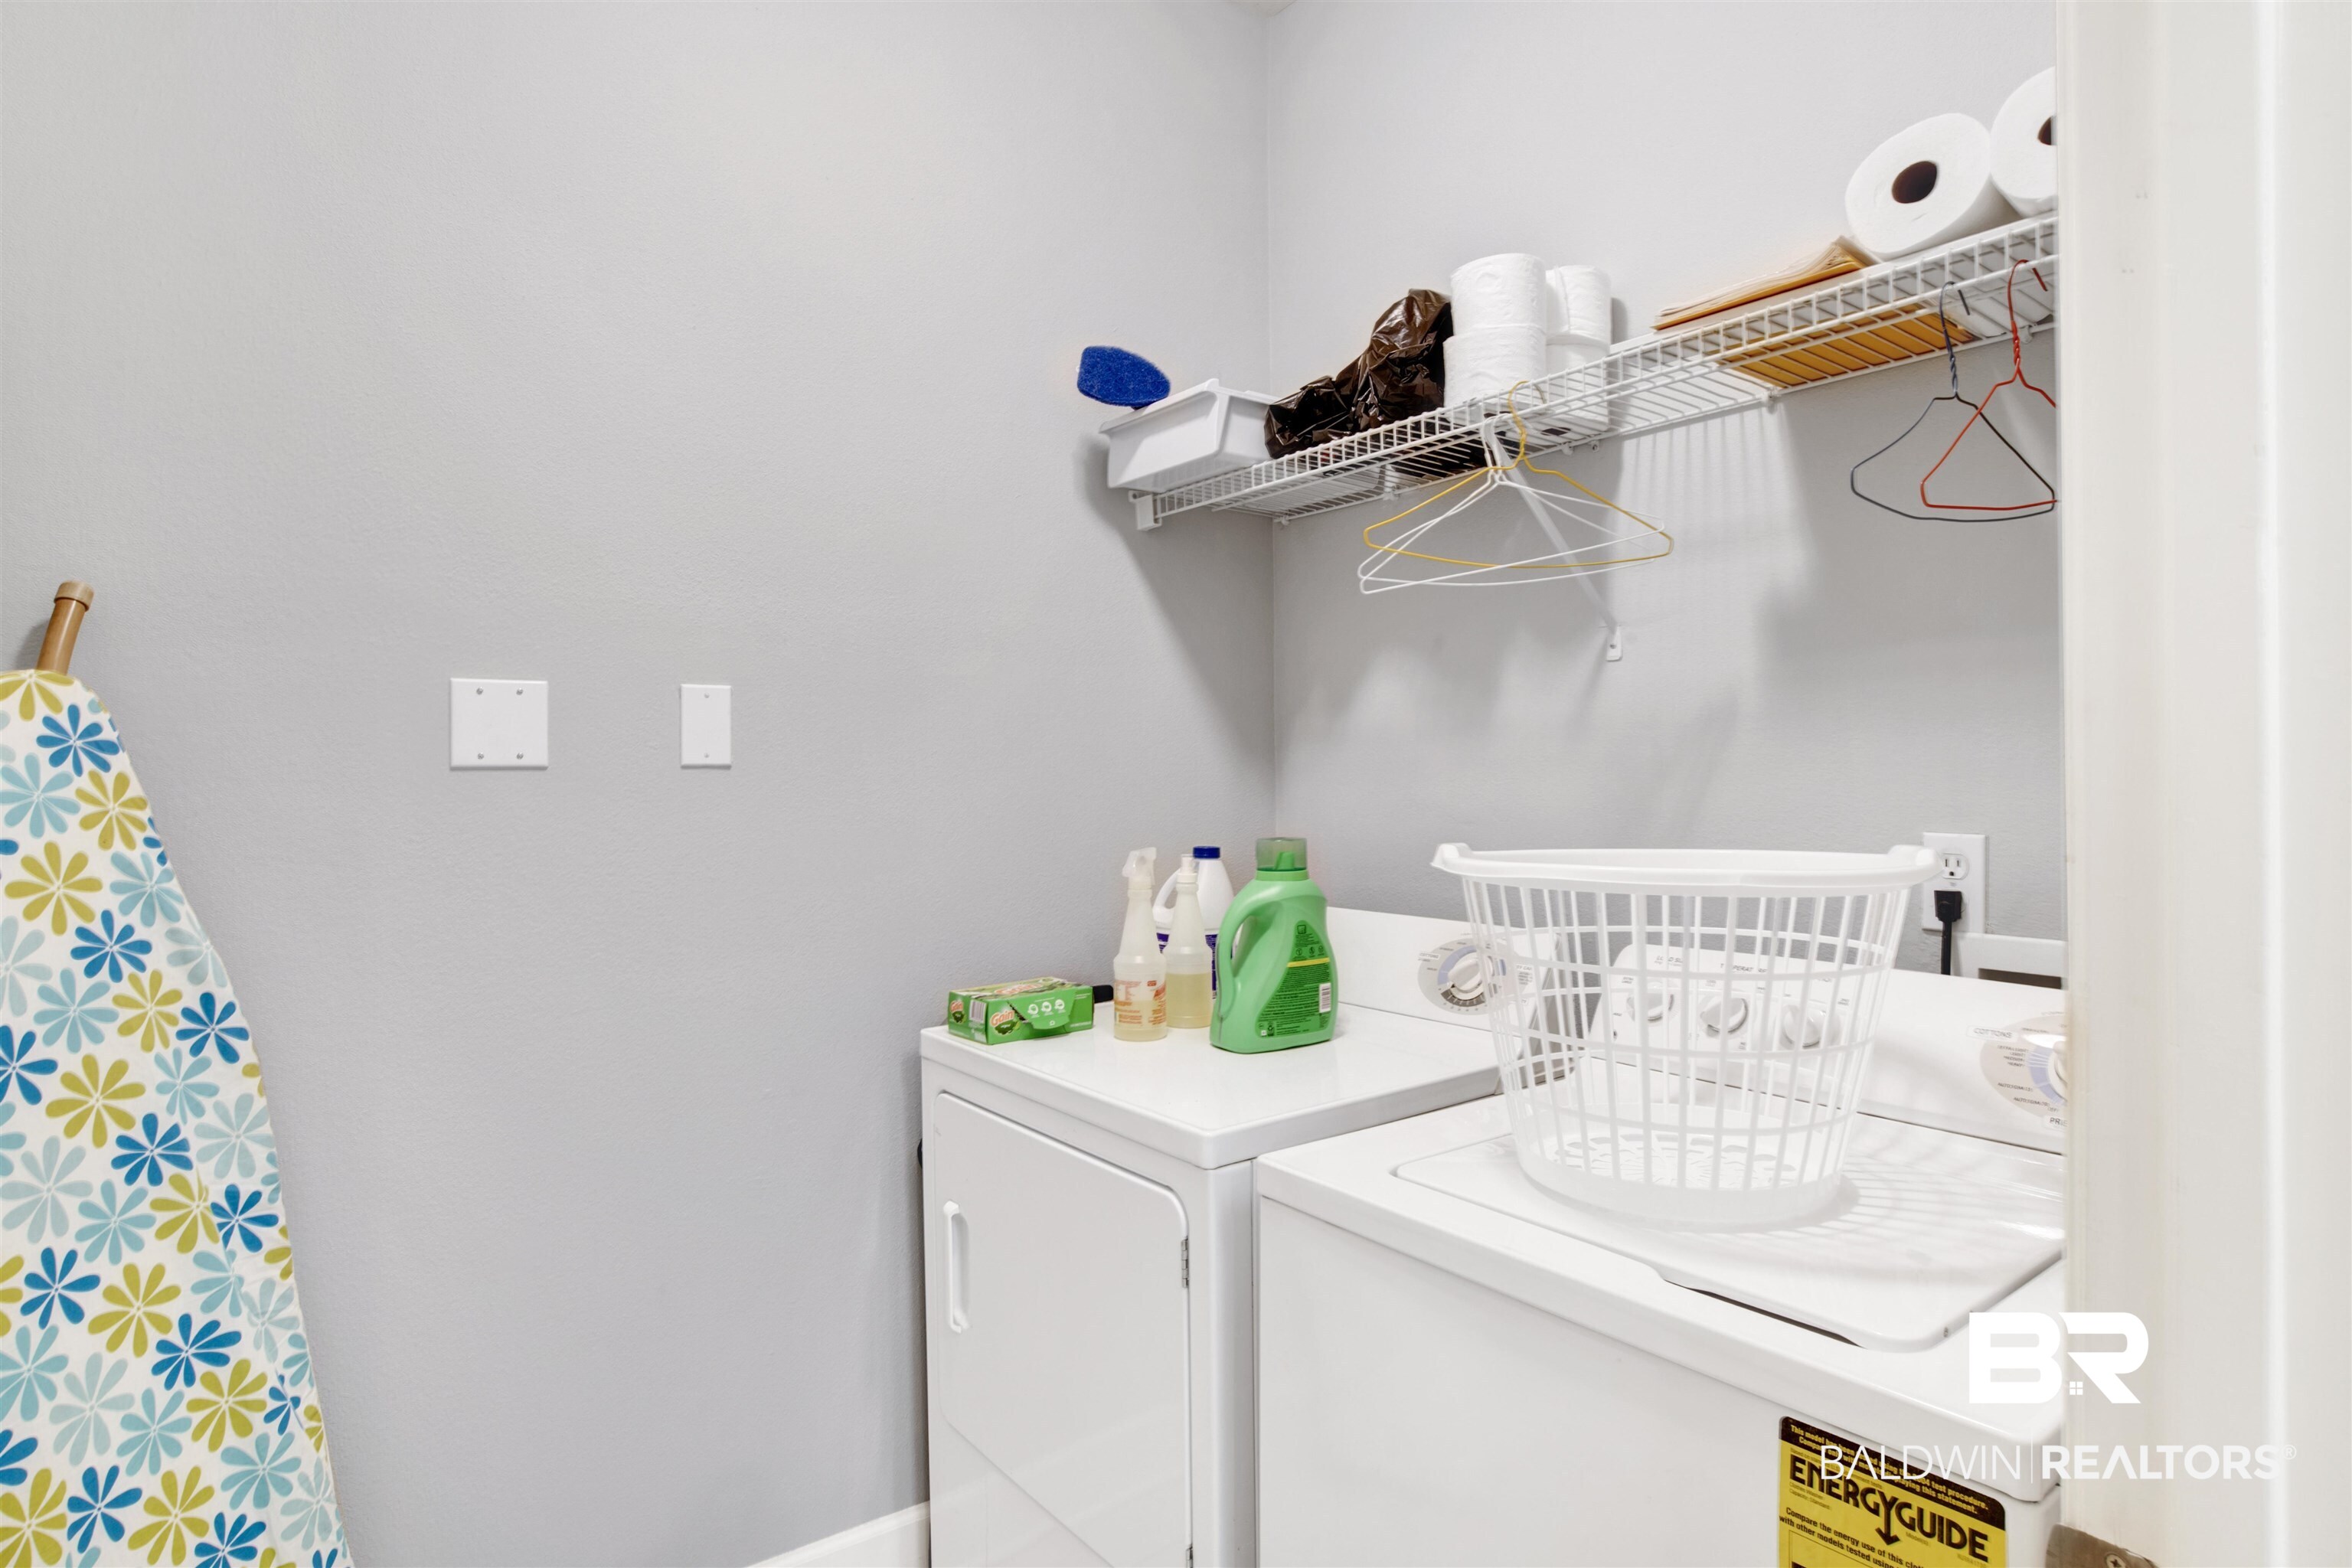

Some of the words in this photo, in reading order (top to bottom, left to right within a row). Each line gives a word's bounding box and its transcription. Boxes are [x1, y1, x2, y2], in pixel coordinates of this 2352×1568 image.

[989, 1009, 1015, 1027] Gain
[1805, 1431, 1824, 1445] model
[1931, 1481, 1947, 1493] test
[1948, 1487, 1989, 1511] procedure.
[1789, 1453, 1989, 1563] ENERGYGUIDE
[1922, 1485, 1936, 1498] this
[1937, 1491, 1978, 1514] statement.
[1779, 1515, 1795, 1527] with
[1796, 1522, 1816, 1537] other
[1817, 1532, 1845, 1550] models
[1846, 1544, 1871, 1562] tested
[1785, 1507, 1818, 1527] Compare
[1819, 1521, 1832, 1534] the
[1834, 1529, 1860, 1547] energy
[1860, 1541, 1876, 1553] use
[1877, 1548, 1886, 1557] of
[1887, 1552, 1904, 1566] this
